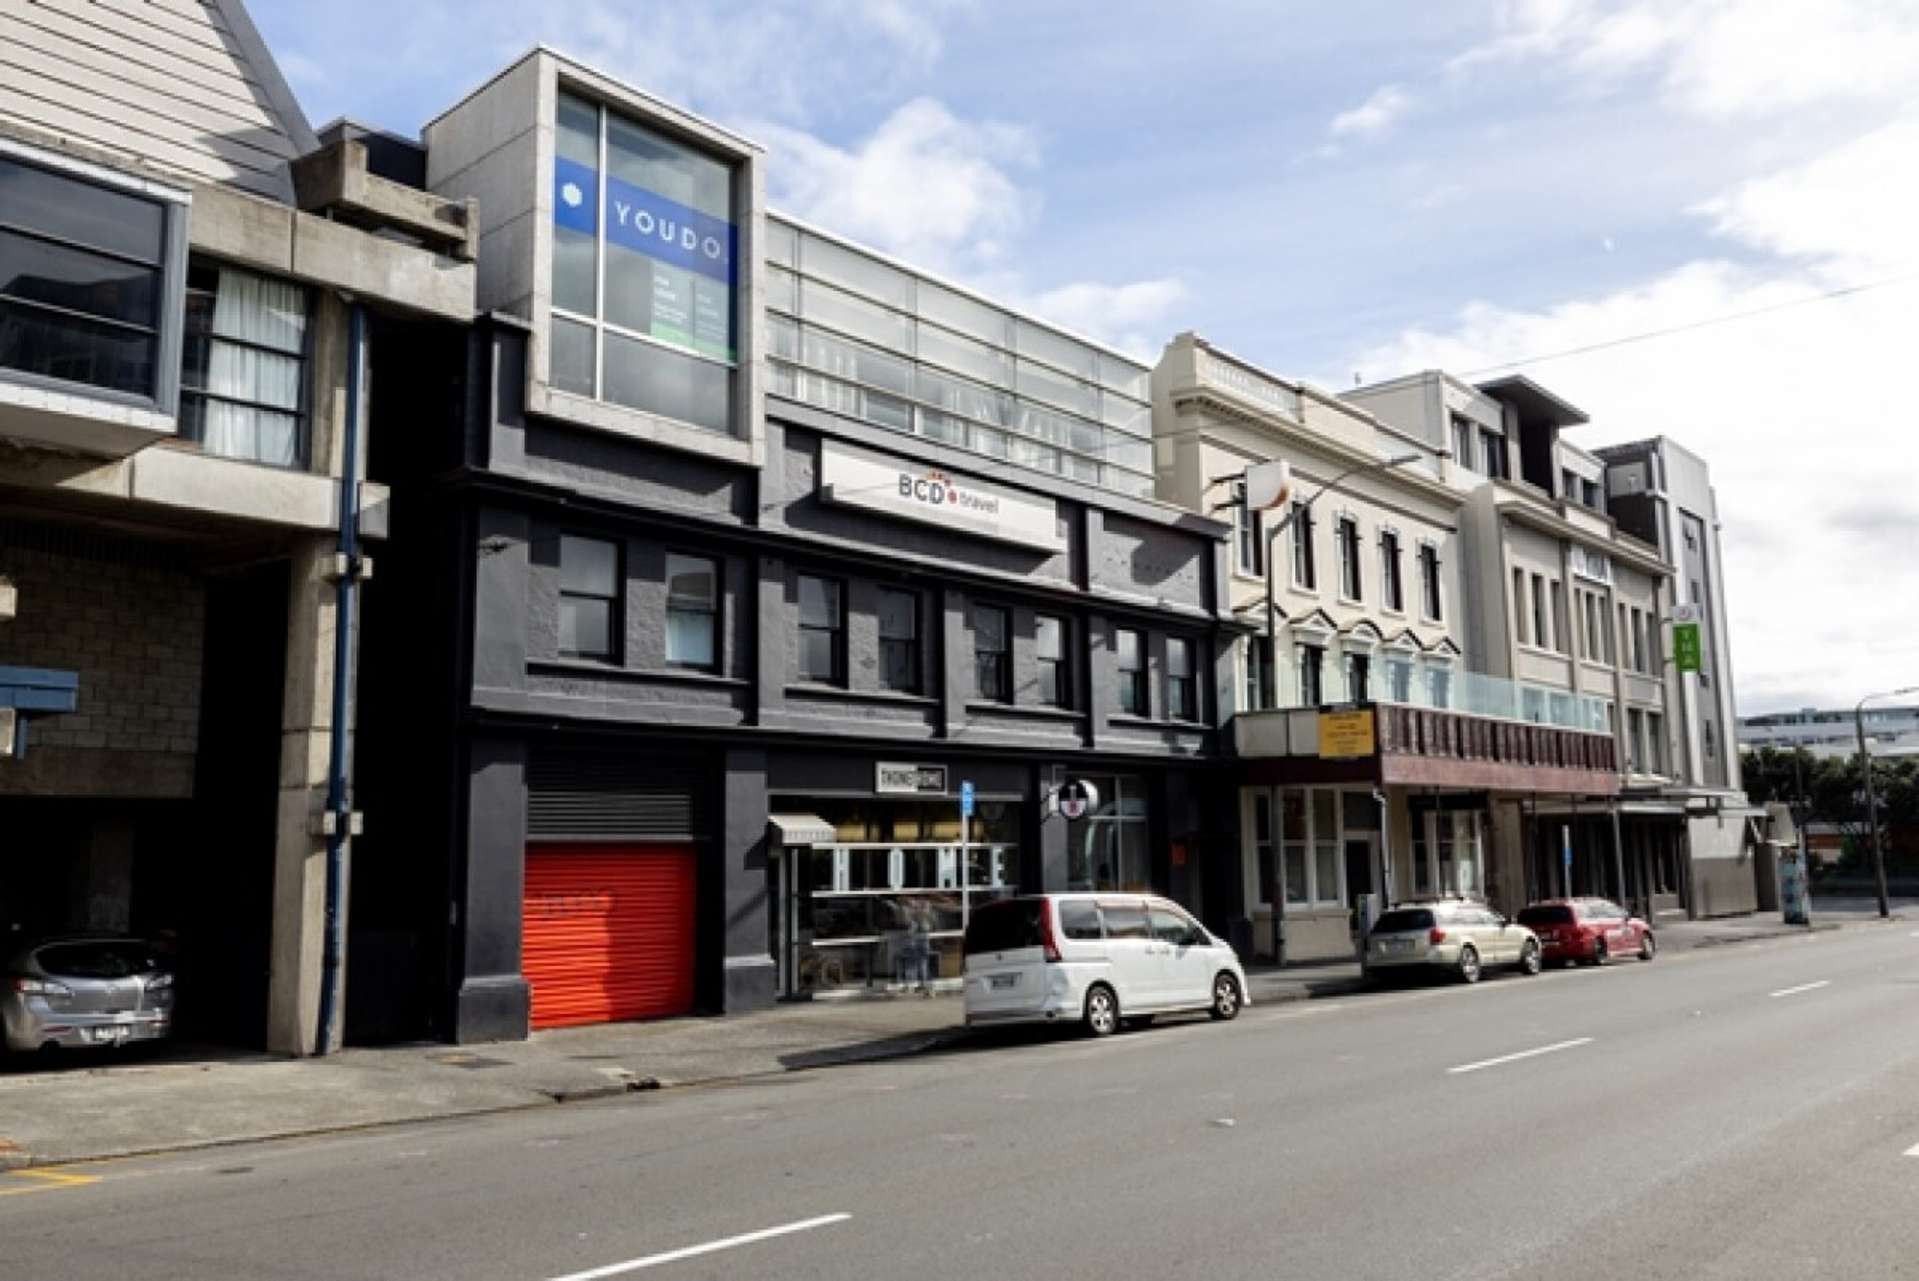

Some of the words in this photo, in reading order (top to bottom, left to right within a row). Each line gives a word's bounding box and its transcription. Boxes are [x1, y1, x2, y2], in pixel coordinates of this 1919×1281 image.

[614, 200, 721, 258] YOUDO
[898, 473, 945, 504] BCD
[959, 491, 1000, 514] travel
